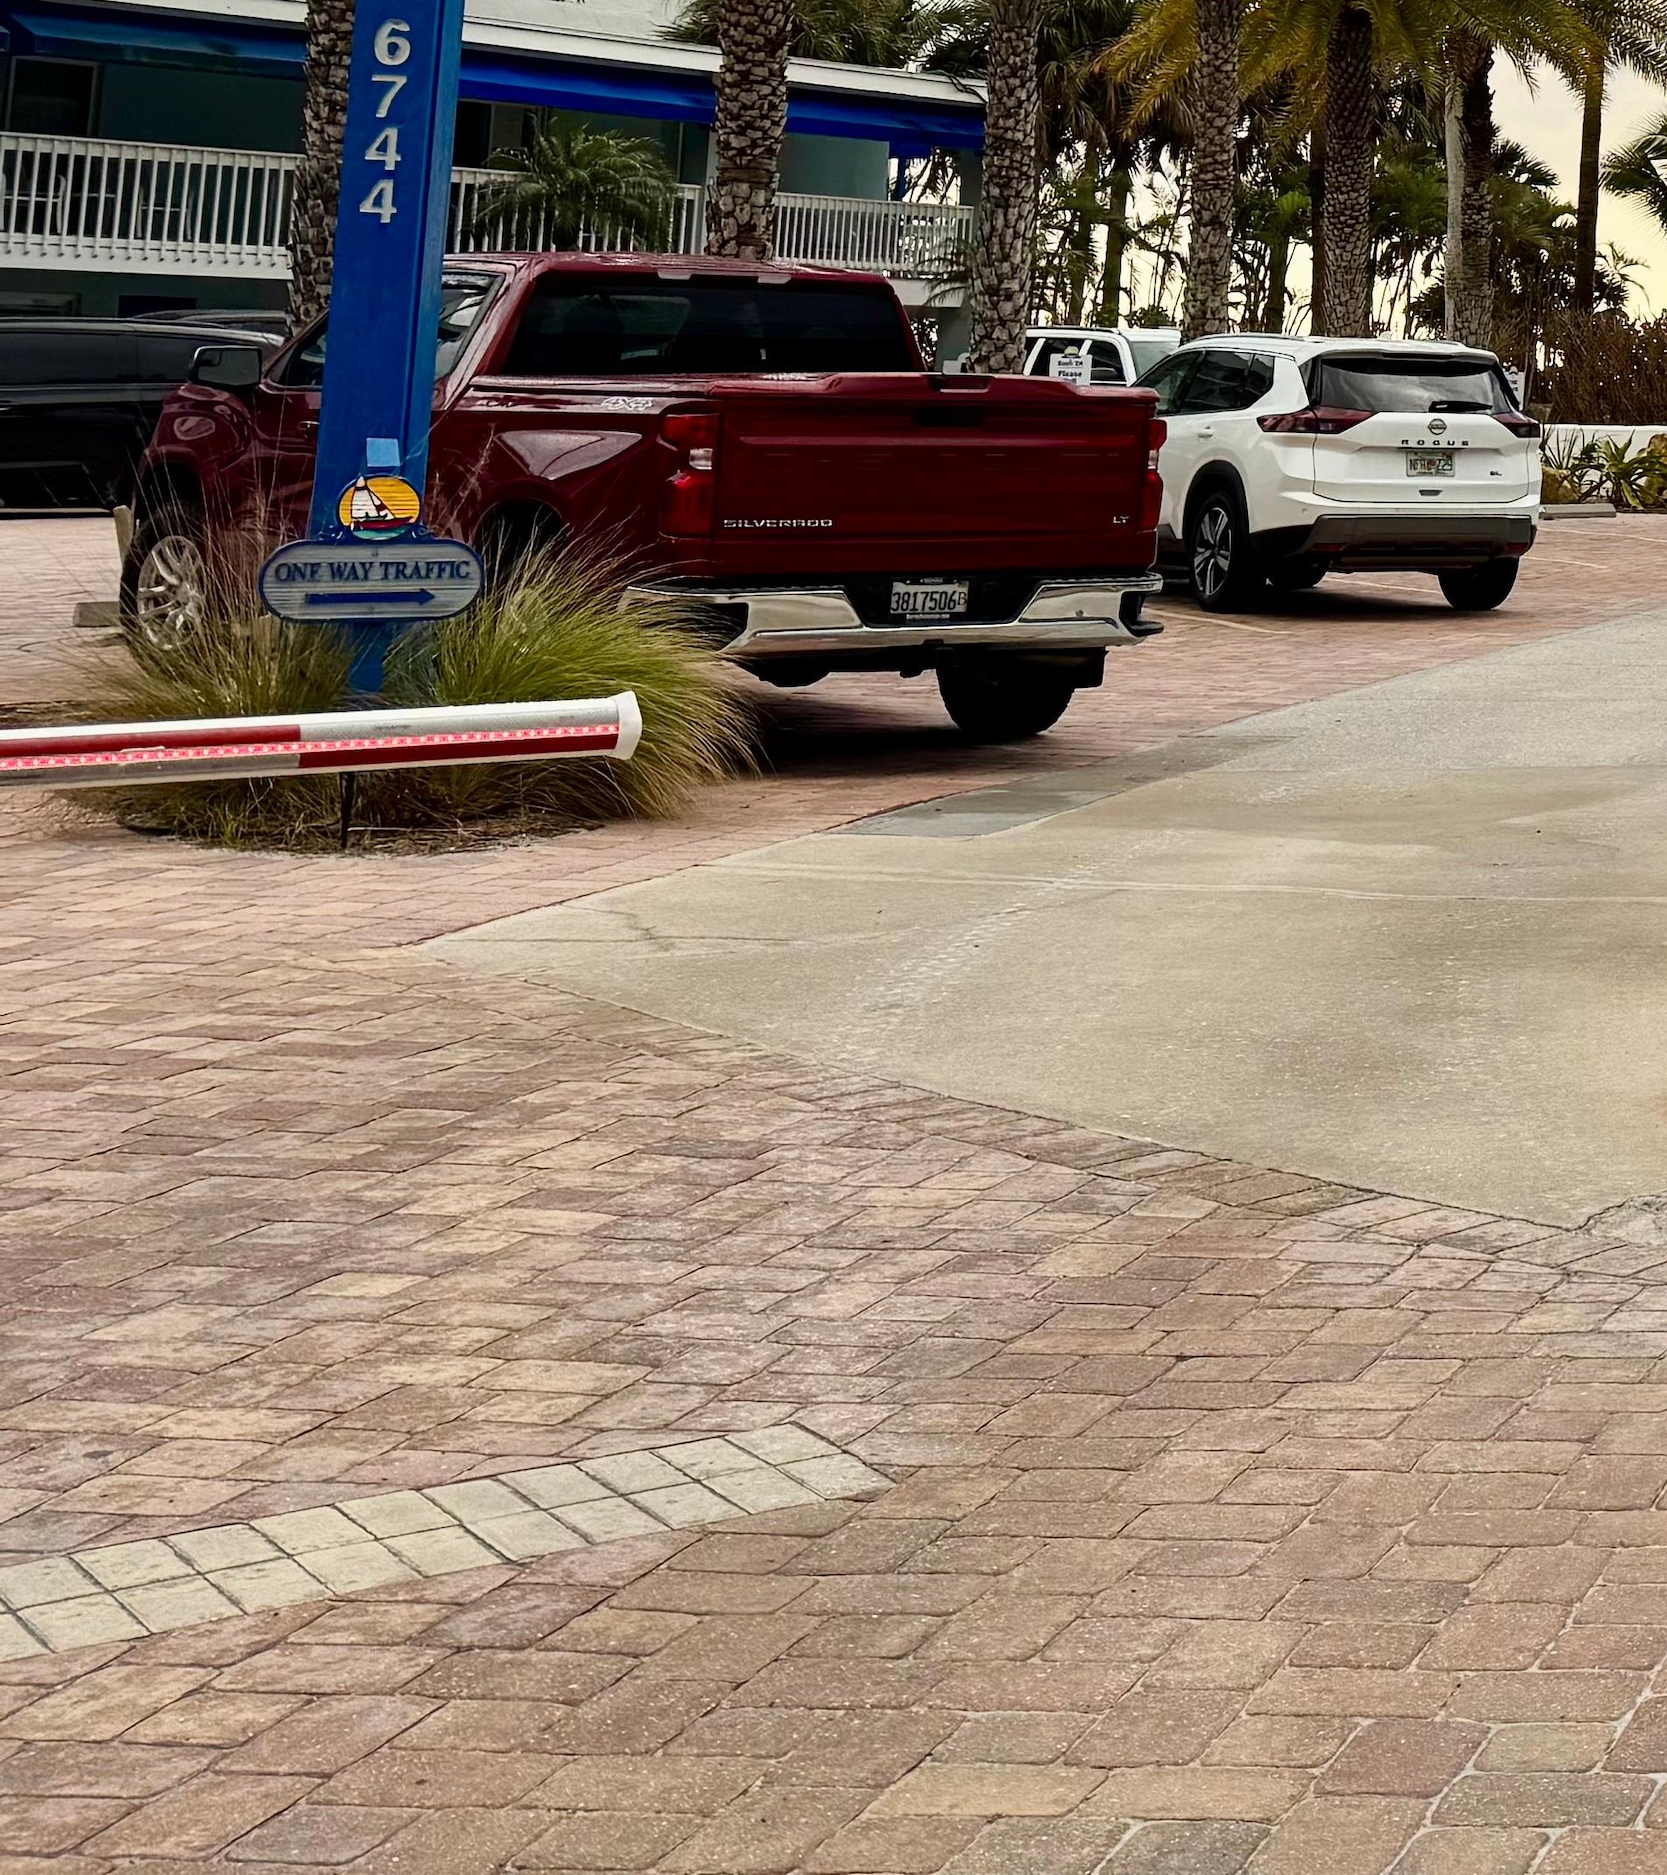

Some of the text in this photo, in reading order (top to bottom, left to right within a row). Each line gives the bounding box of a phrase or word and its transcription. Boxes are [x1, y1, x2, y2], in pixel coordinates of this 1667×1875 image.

[359, 18, 412, 224] 6744
[723, 519, 834, 528] SILVERADO
[1113, 516, 1129, 524] LT
[274, 560, 471, 582] ONE WAY TRAFFIC
